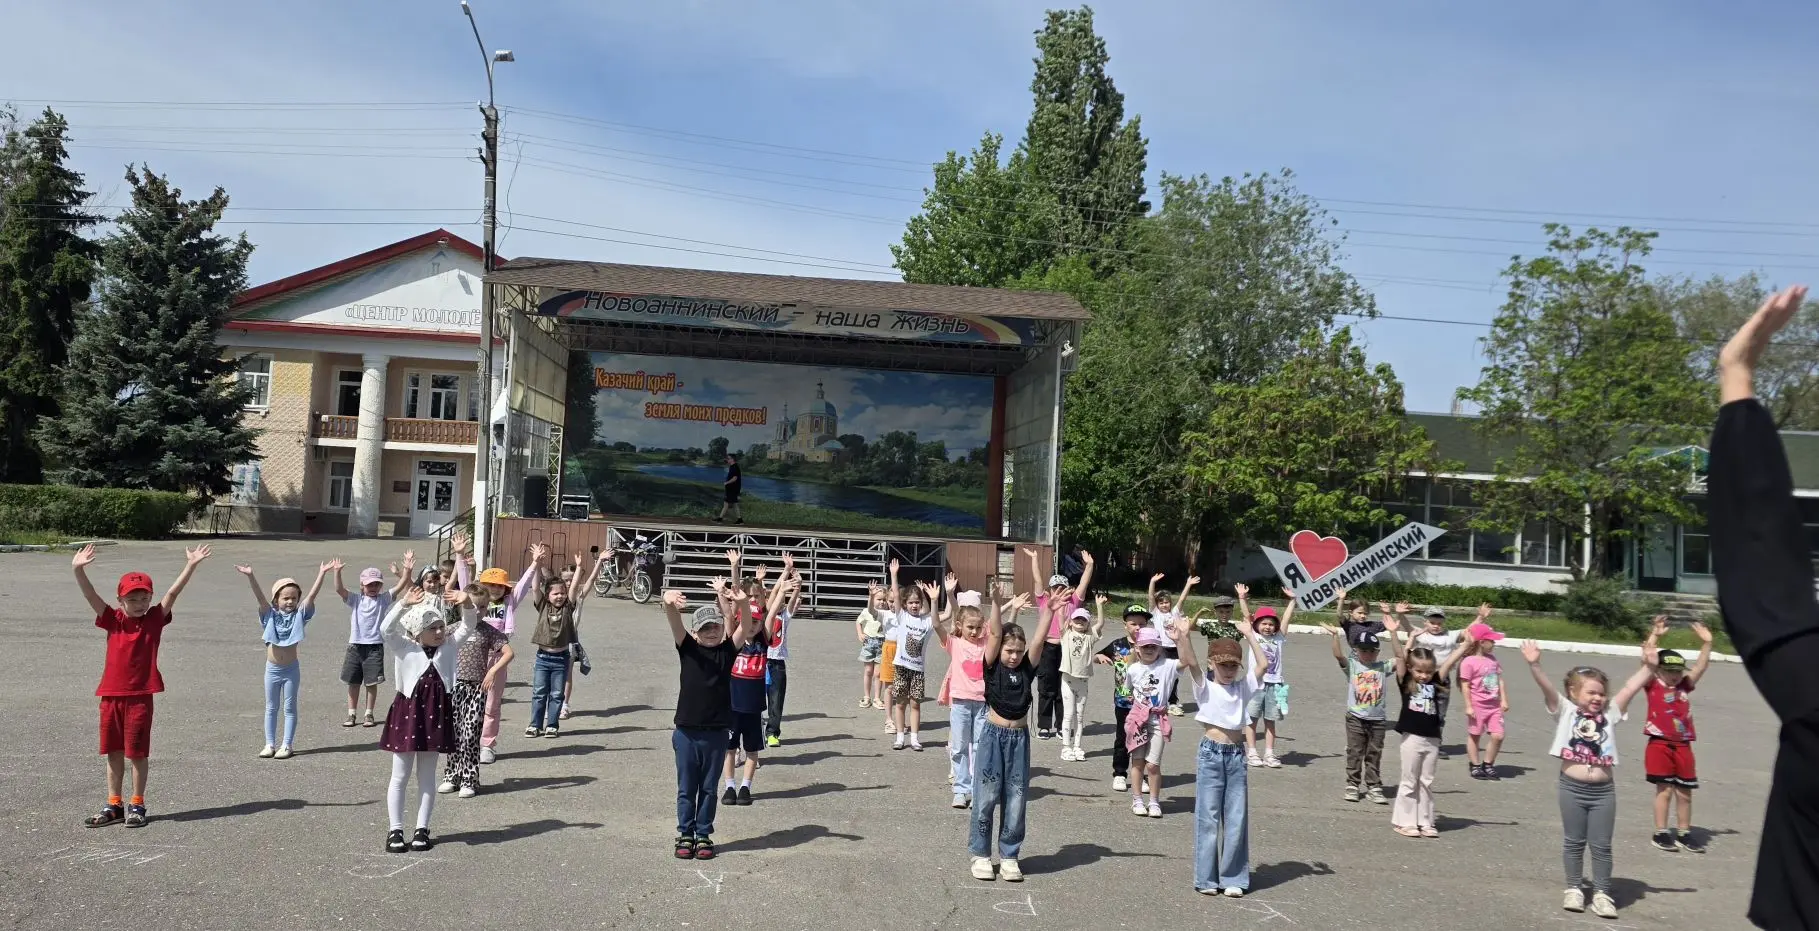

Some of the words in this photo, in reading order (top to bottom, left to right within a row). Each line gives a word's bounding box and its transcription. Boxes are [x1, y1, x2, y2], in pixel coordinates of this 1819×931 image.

[345, 304, 407, 321] «ЦЕНТР
[412, 307, 481, 326] МОЛОДЁ
[583, 291, 780, 323] Новоаннинский
[815, 311, 881, 329] наша
[595, 368, 645, 391] Казачий
[646, 373, 676, 394] край
[644, 402, 680, 419] земля
[682, 405, 714, 422] моих
[714, 406, 768, 426] предков!
[1283, 563, 1306, 589] Я
[1301, 524, 1427, 610] НОВОАННИНСКИЙ
